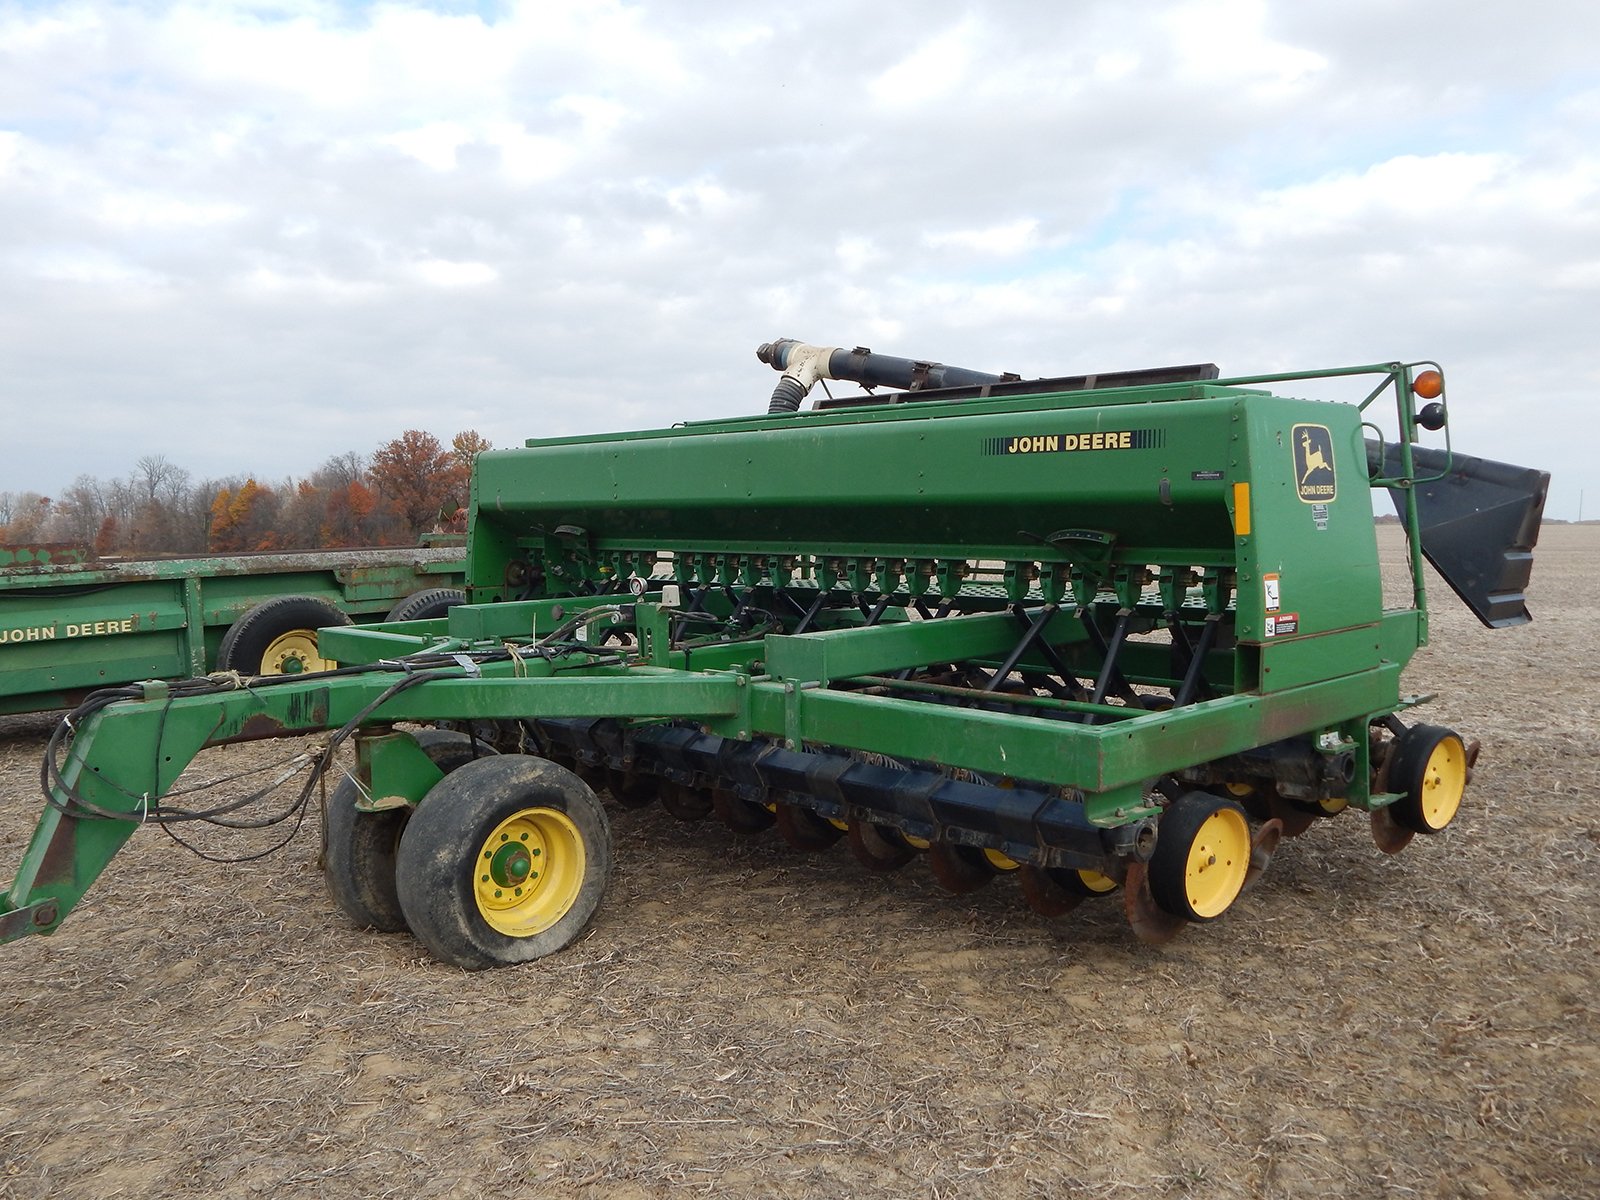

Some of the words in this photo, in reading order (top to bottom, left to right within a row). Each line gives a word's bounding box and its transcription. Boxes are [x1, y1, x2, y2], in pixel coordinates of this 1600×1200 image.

[1008, 435, 1058, 454] JOHN
[1065, 432, 1131, 451] DEERE
[1300, 485, 1316, 495] JOHN
[1317, 485, 1334, 495] DEERE
[0, 626, 55, 643] JOHN
[66, 620, 132, 637] DEERE
